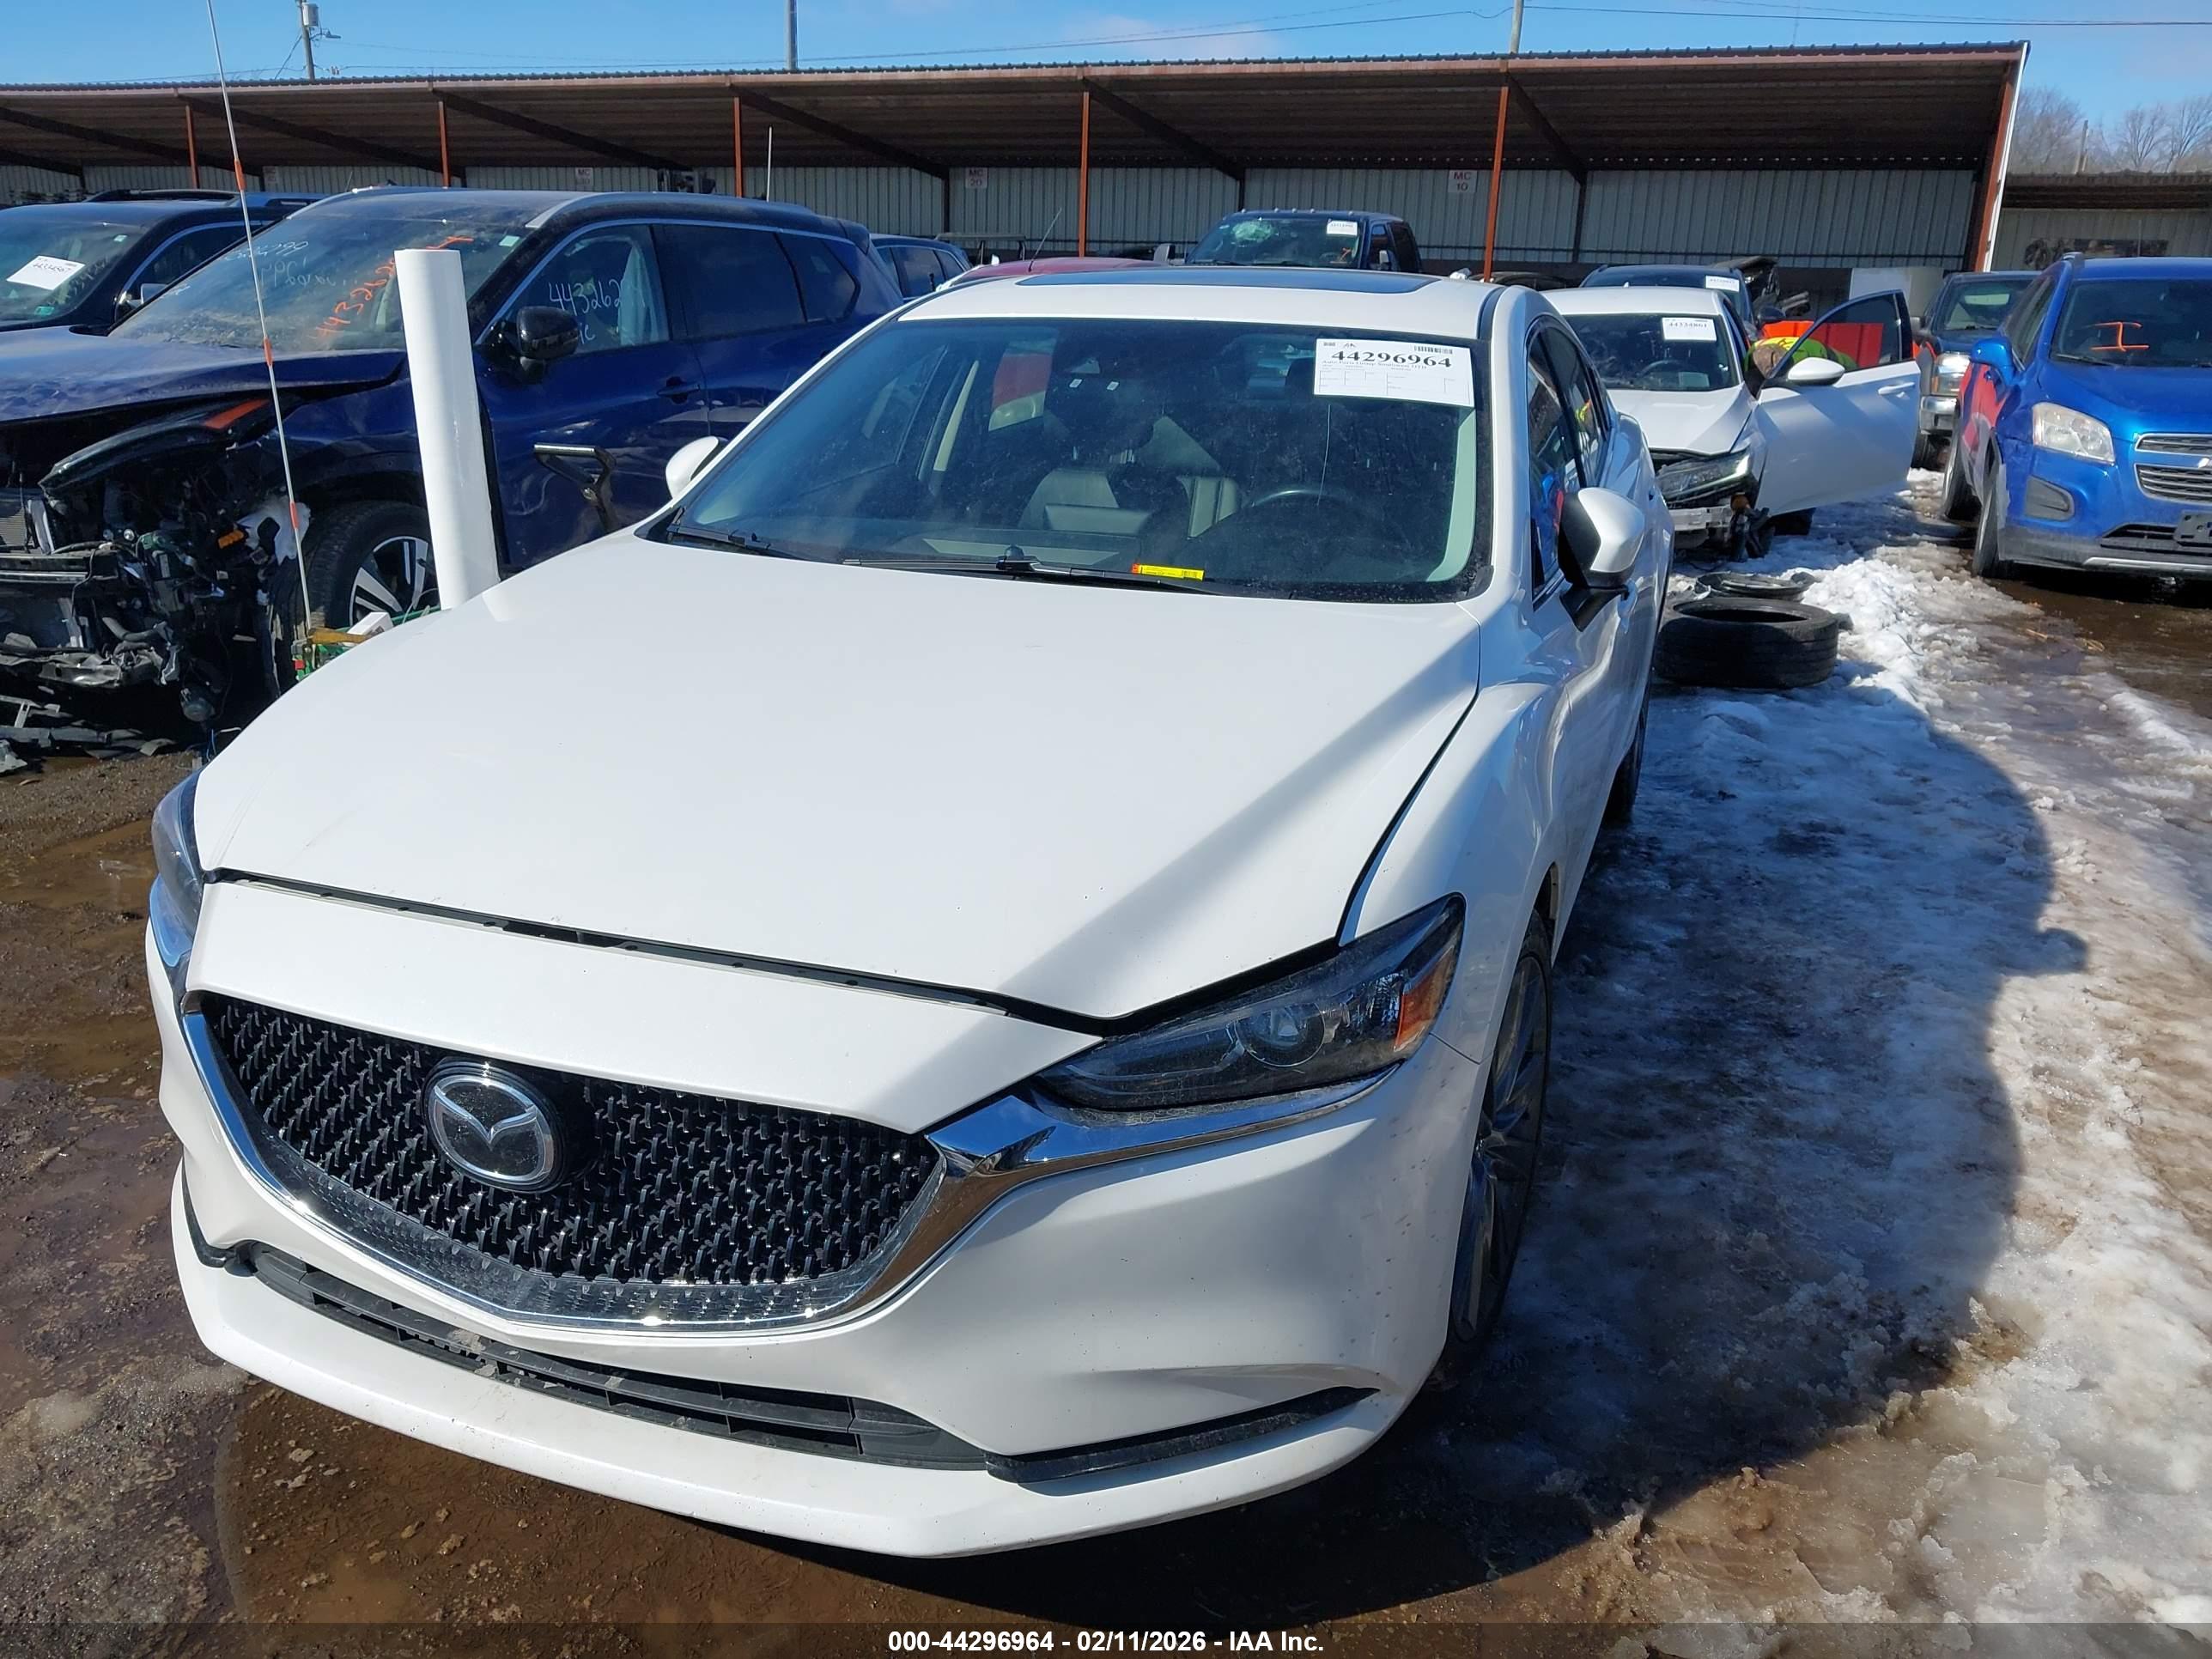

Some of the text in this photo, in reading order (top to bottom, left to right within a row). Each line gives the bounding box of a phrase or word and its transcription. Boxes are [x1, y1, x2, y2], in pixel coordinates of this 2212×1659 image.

[1454, 171, 1472, 179] MC
[1456, 181, 1469, 191] 10
[1331, 349, 1452, 368] 44296964
